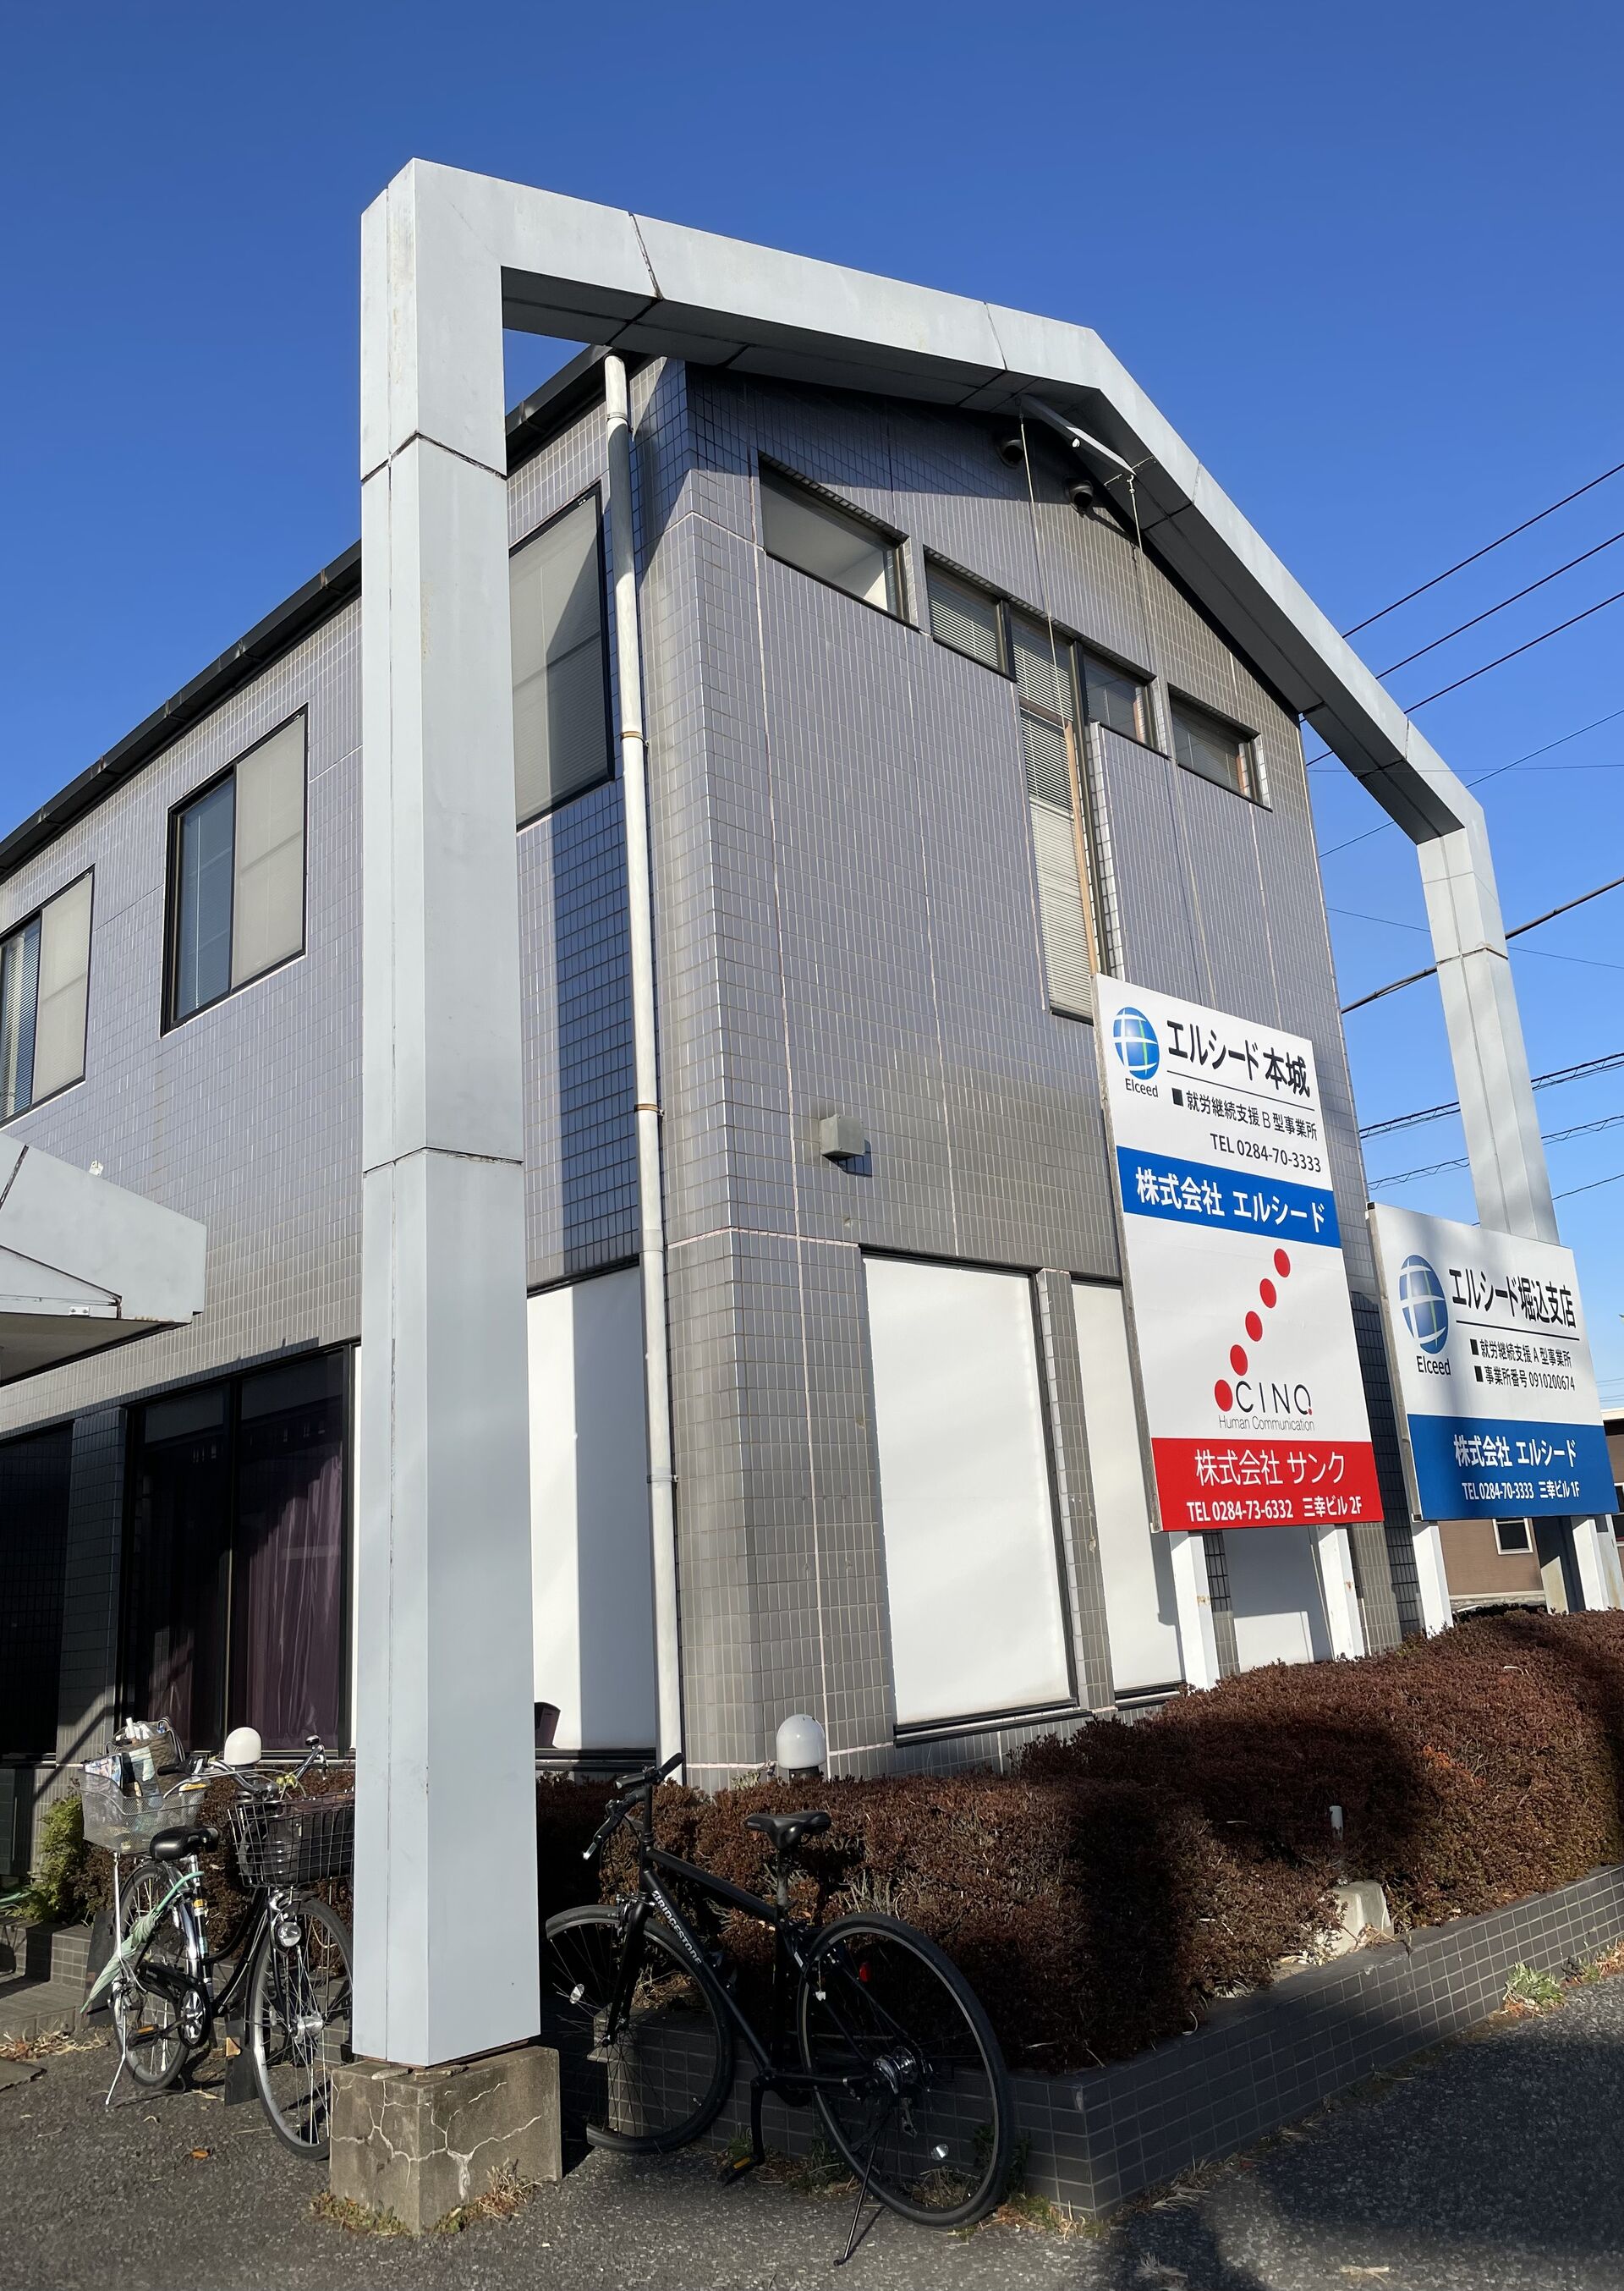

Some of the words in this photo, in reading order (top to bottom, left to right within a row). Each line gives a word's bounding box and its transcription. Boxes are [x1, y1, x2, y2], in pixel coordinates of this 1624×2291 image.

[1125, 1078, 1159, 1098] Elceed
[1210, 1133, 1235, 1154] TEL
[1237, 1140, 1321, 1173] 0284-70-3333
[1135, 1166, 1226, 1217] 株式会社
[1232, 1190, 1325, 1233] エルシード
[1449, 1268, 1577, 1328] エルシード堀込支店
[1416, 1355, 1451, 1376] Elceed
[1484, 1365, 1528, 1387] 事業所番号
[1528, 1372, 1575, 1391] 0910200674
[1236, 1381, 1312, 1415] CINQ
[1218, 1415, 1250, 1430] Human
[1252, 1416, 1315, 1431] Communication
[1194, 1449, 1283, 1486] 株式会社
[1287, 1452, 1344, 1484] サンク
[1454, 1434, 1513, 1468] 株式会社
[1516, 1438, 1577, 1468] エルシード
[1462, 1482, 1479, 1500] TEL
[1479, 1482, 1534, 1500] 0284-70-3333
[1538, 1480, 1570, 1499] 三幸ビル
[1571, 1481, 1580, 1497] 1F
[1187, 1502, 1210, 1522] TEL
[1212, 1499, 1293, 1521] 0284-73-6332
[1302, 1495, 1348, 1518] 三幸ビル
[1349, 1496, 1362, 1514] 2F
[651, 1890, 702, 1964] BRIDGESTONE
